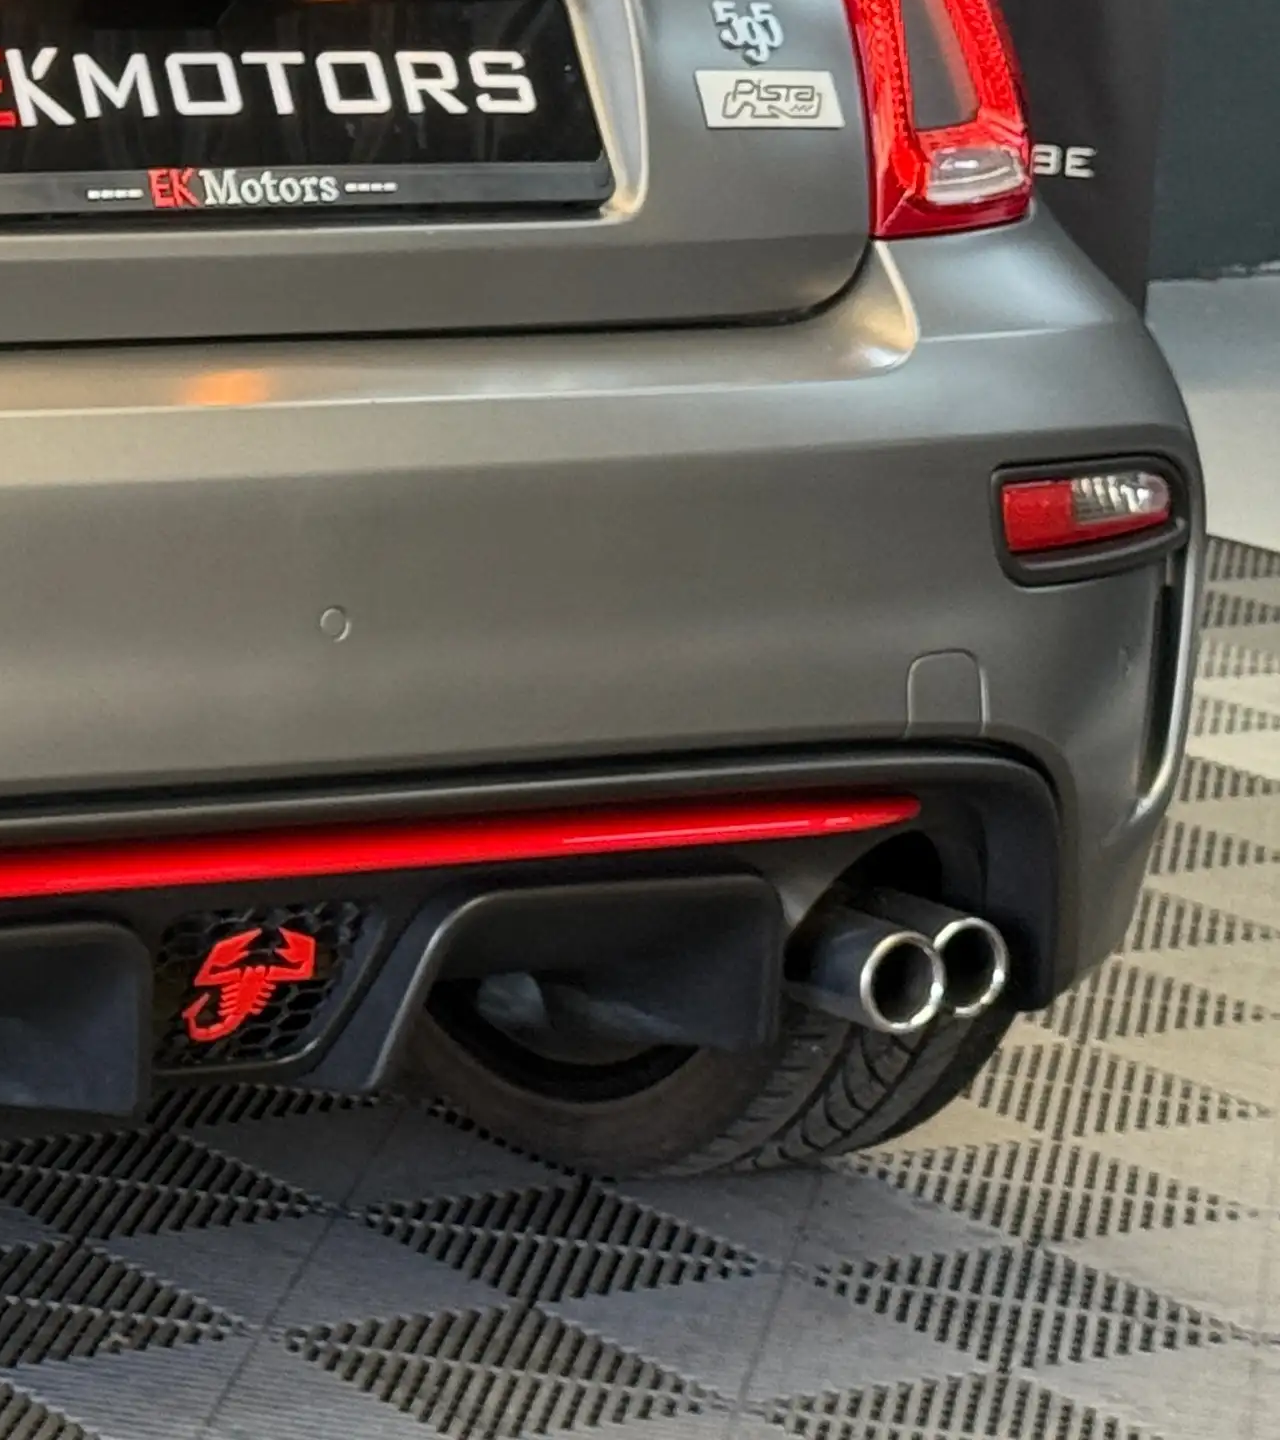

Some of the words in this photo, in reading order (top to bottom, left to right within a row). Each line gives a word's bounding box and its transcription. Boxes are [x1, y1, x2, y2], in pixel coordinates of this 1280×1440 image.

[711, 0, 785, 64] 595
[147, 167, 199, 208] EK
[198, 168, 341, 206] Motors
